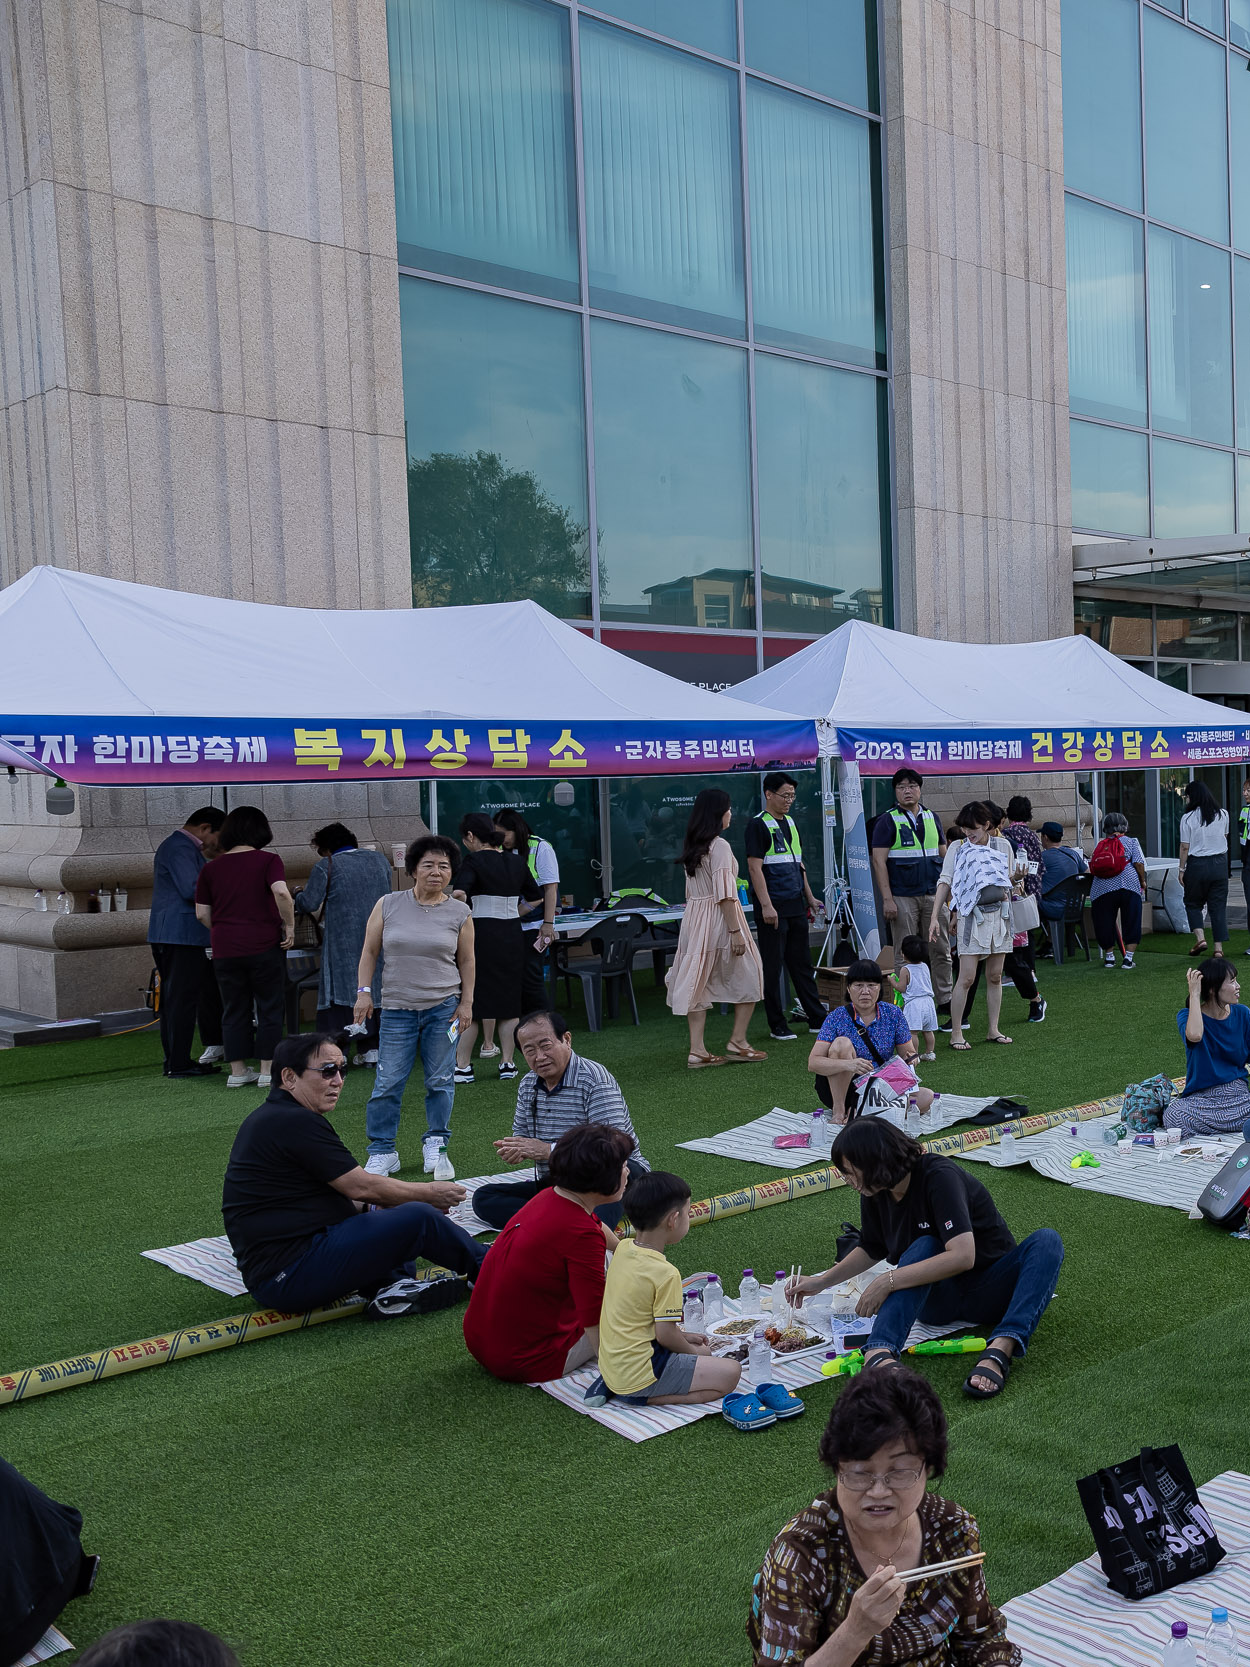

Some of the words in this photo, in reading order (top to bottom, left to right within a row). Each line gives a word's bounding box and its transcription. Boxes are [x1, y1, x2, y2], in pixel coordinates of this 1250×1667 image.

[698, 682, 732, 691] PLACE
[93, 734, 268, 764] 한마당축제
[293, 728, 588, 771] 복지상담소
[625, 739, 756, 759] 군자동주민센터
[855, 741, 906, 760] 2023
[910, 740, 943, 762] 군자
[947, 739, 1023, 761] 한마당축제
[1031, 730, 1170, 763] 건강상담소
[757, 1180, 789, 1199] 출입금지
[187, 1321, 240, 1345] 안전선
[112, 1337, 171, 1363] 출입금지
[37, 1365, 62, 1383] LINE
[62, 1355, 96, 1377] SAFETY
